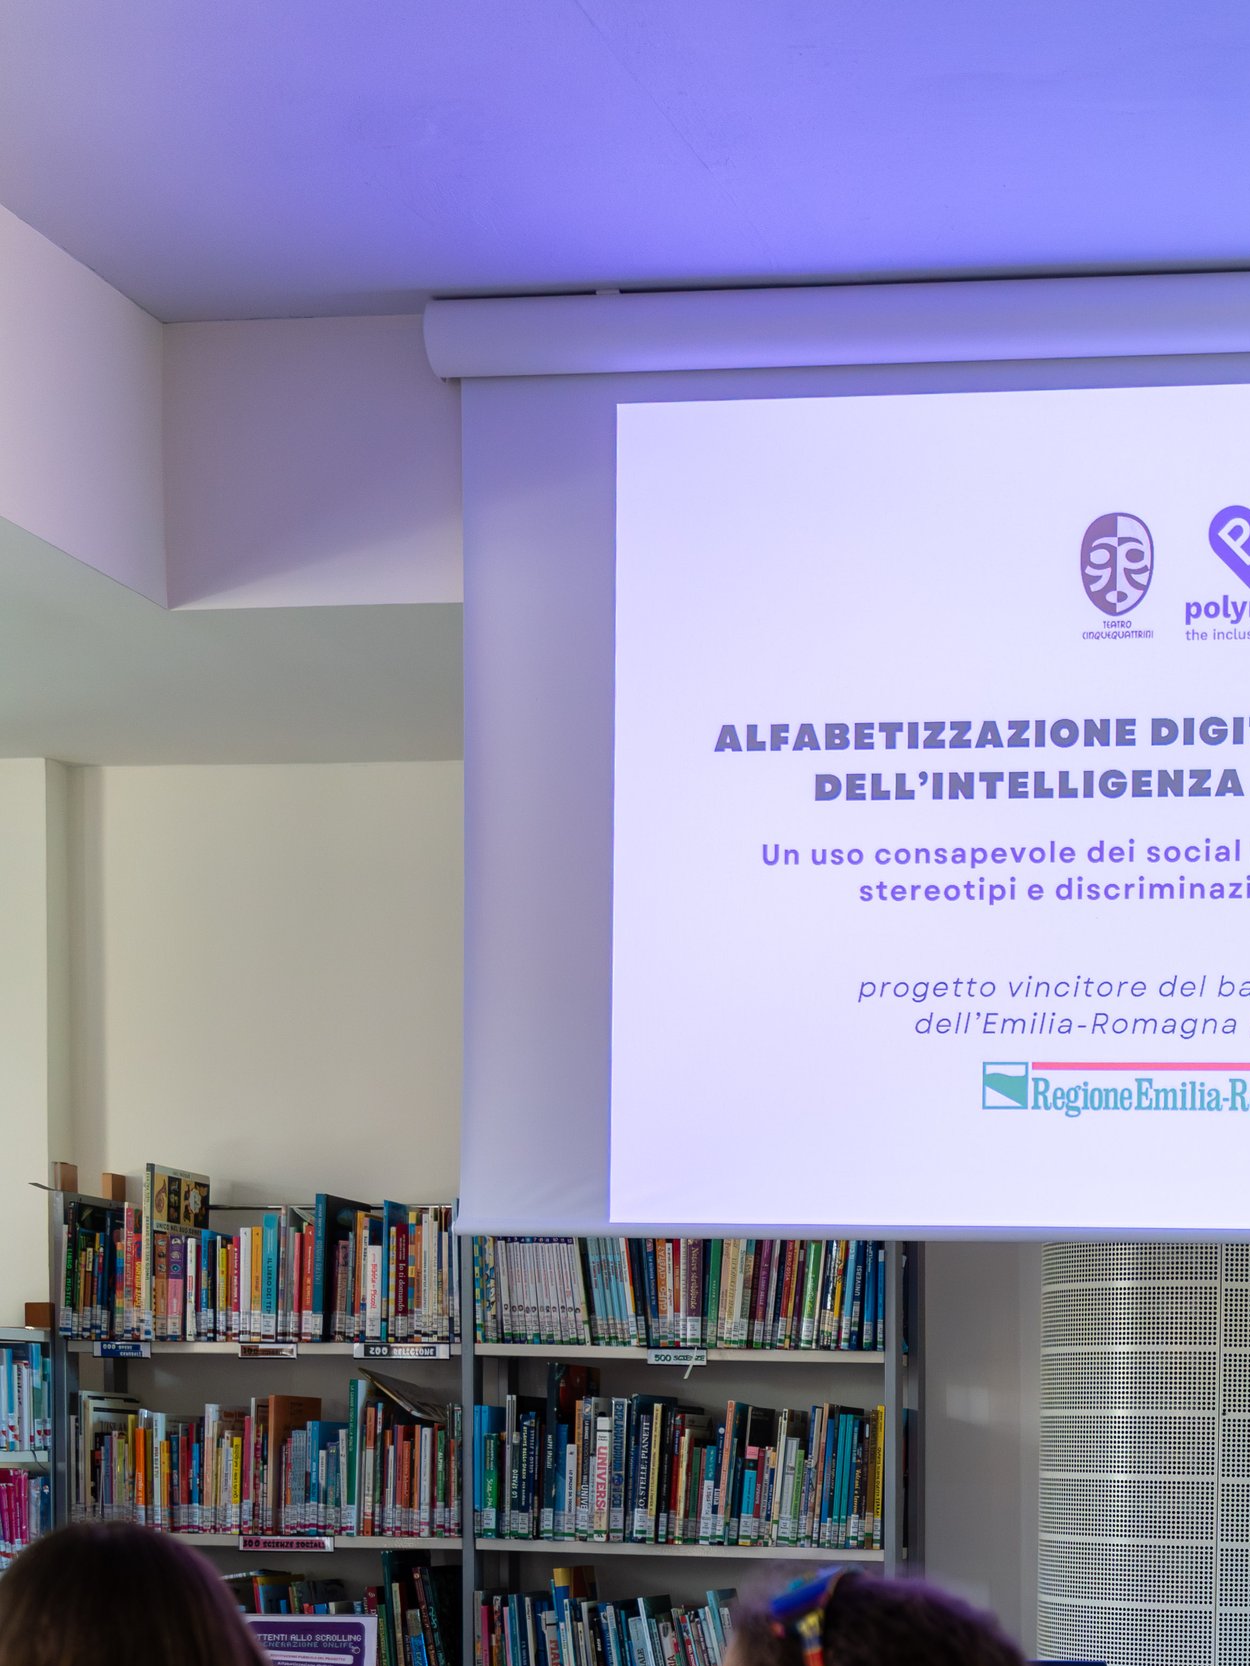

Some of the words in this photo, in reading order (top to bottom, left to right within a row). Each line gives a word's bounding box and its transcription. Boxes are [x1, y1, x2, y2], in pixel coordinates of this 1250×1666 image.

[1103, 621, 1132, 629] TEATRO
[1185, 629, 1208, 640] the
[714, 718, 1136, 752] ALFABETIZZAZIONE
[815, 769, 1244, 801] DELL’INTELLIGENZA
[763, 844, 799, 865] Un
[812, 849, 863, 865] uso
[875, 841, 1076, 869] consapevole
[1087, 839, 1134, 863] dei
[1147, 838, 1240, 863] social
[860, 876, 1016, 905] stereotipi
[1028, 884, 1044, 900] e
[858, 978, 995, 1003] progetto
[1009, 975, 1146, 997] vincitore
[1159, 975, 1206, 997] del
[915, 1012, 1236, 1039] dell’Emilia-Romagna
[397, 1279, 406, 1312] domando
[658, 1286, 668, 1311] GUFO
[369, 1346, 389, 1355] 200
[654, 1354, 672, 1362] 500
[612, 1403, 625, 1472] EXPLANATORIUM
[641, 1421, 651, 1460] PIANETI
[596, 1446, 609, 1511] UNIVERS
[242, 1539, 261, 1548] 300
[262, 1541, 294, 1549] SCIENZE
[256, 1633, 288, 1642] TTENTI
[290, 1633, 313, 1642] ALLO
[315, 1634, 362, 1642] SCROLLING
